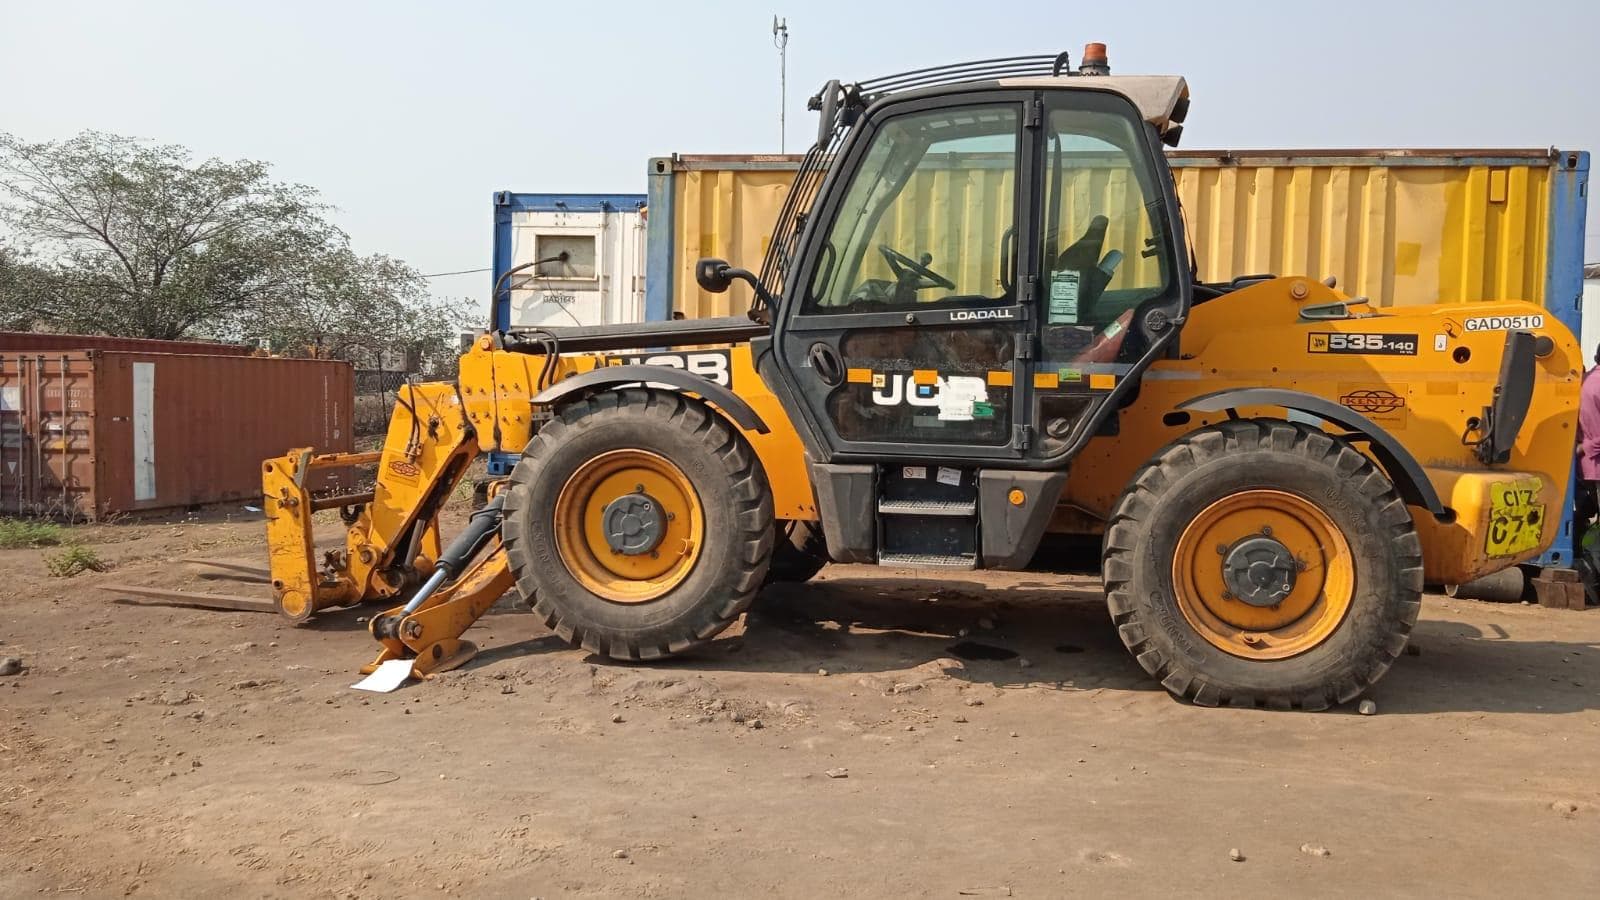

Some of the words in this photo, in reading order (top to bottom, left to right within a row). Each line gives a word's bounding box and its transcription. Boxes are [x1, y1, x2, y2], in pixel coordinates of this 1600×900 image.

[950, 309, 1013, 321] LOADALL
[1465, 315, 1542, 332] GAD0510
[1329, 334, 1414, 350] 535-140
[872, 374, 986, 406] JC
[1346, 398, 1398, 406] KENTZ
